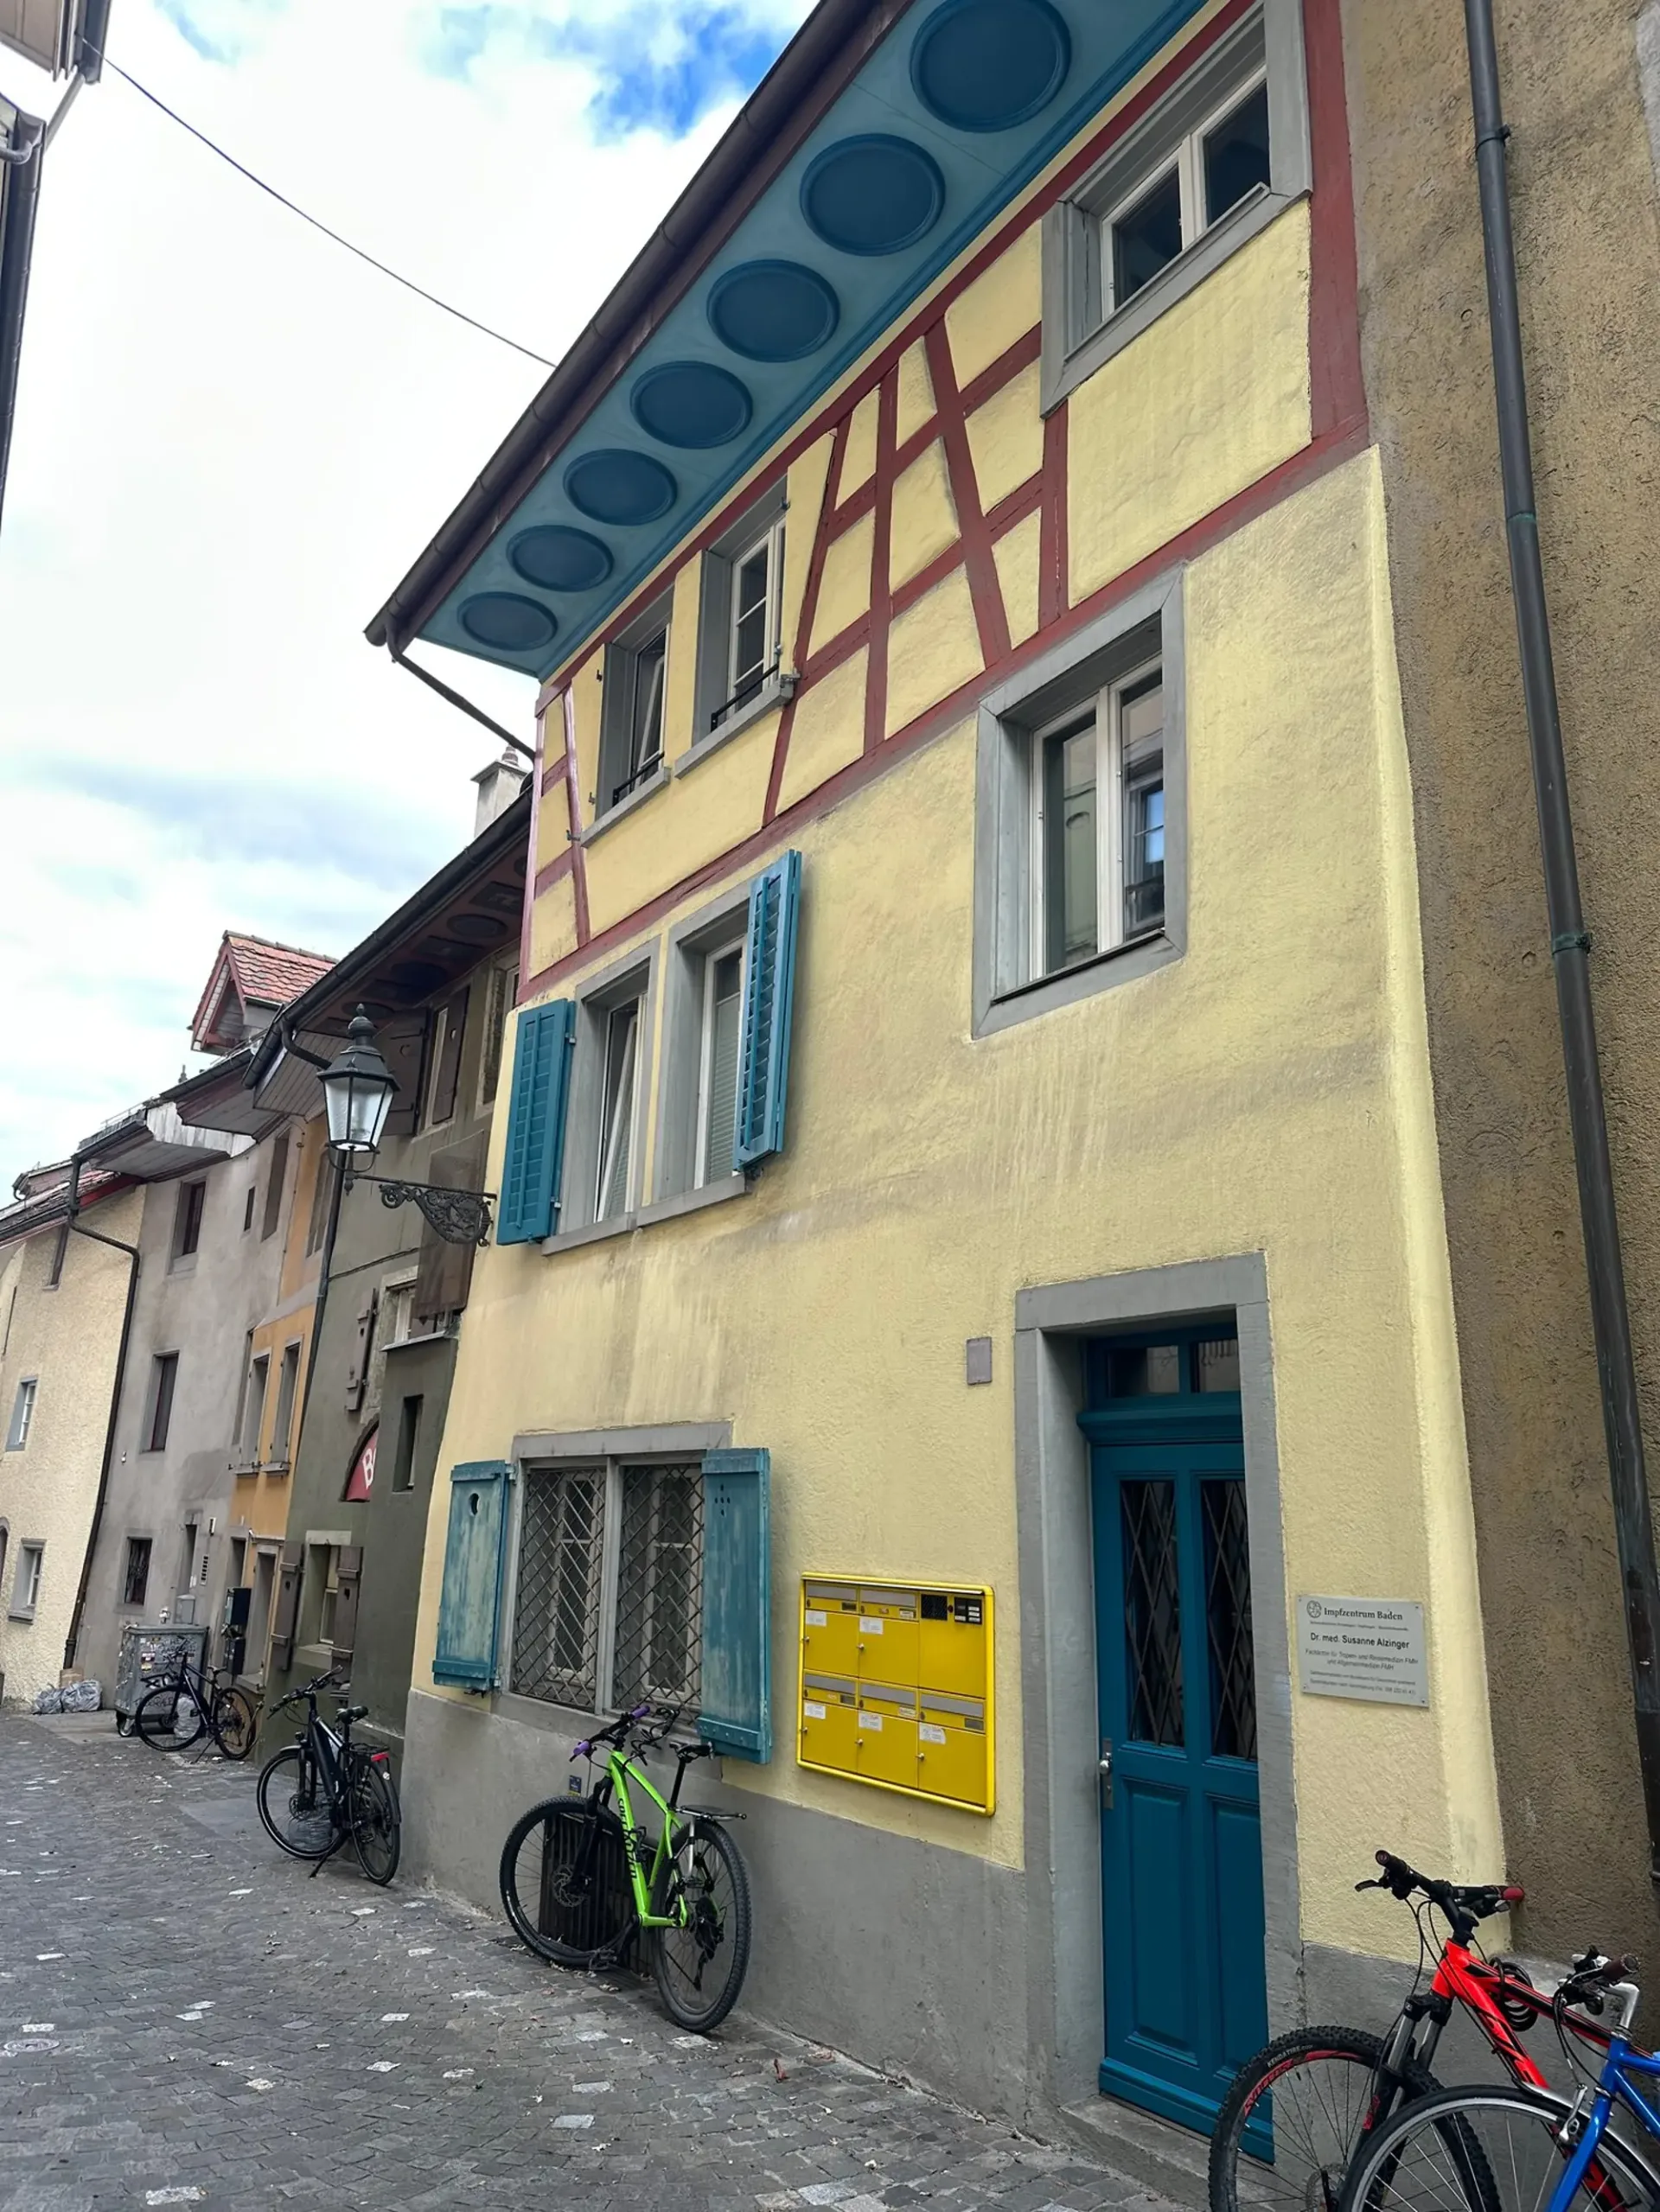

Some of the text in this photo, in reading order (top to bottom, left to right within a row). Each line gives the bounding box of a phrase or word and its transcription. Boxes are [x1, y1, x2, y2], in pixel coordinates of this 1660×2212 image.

[1324, 1608, 1403, 1621] Impfzentrum Baden
[1310, 1632, 1410, 1650] Dr. med. Susanne Alzinger
